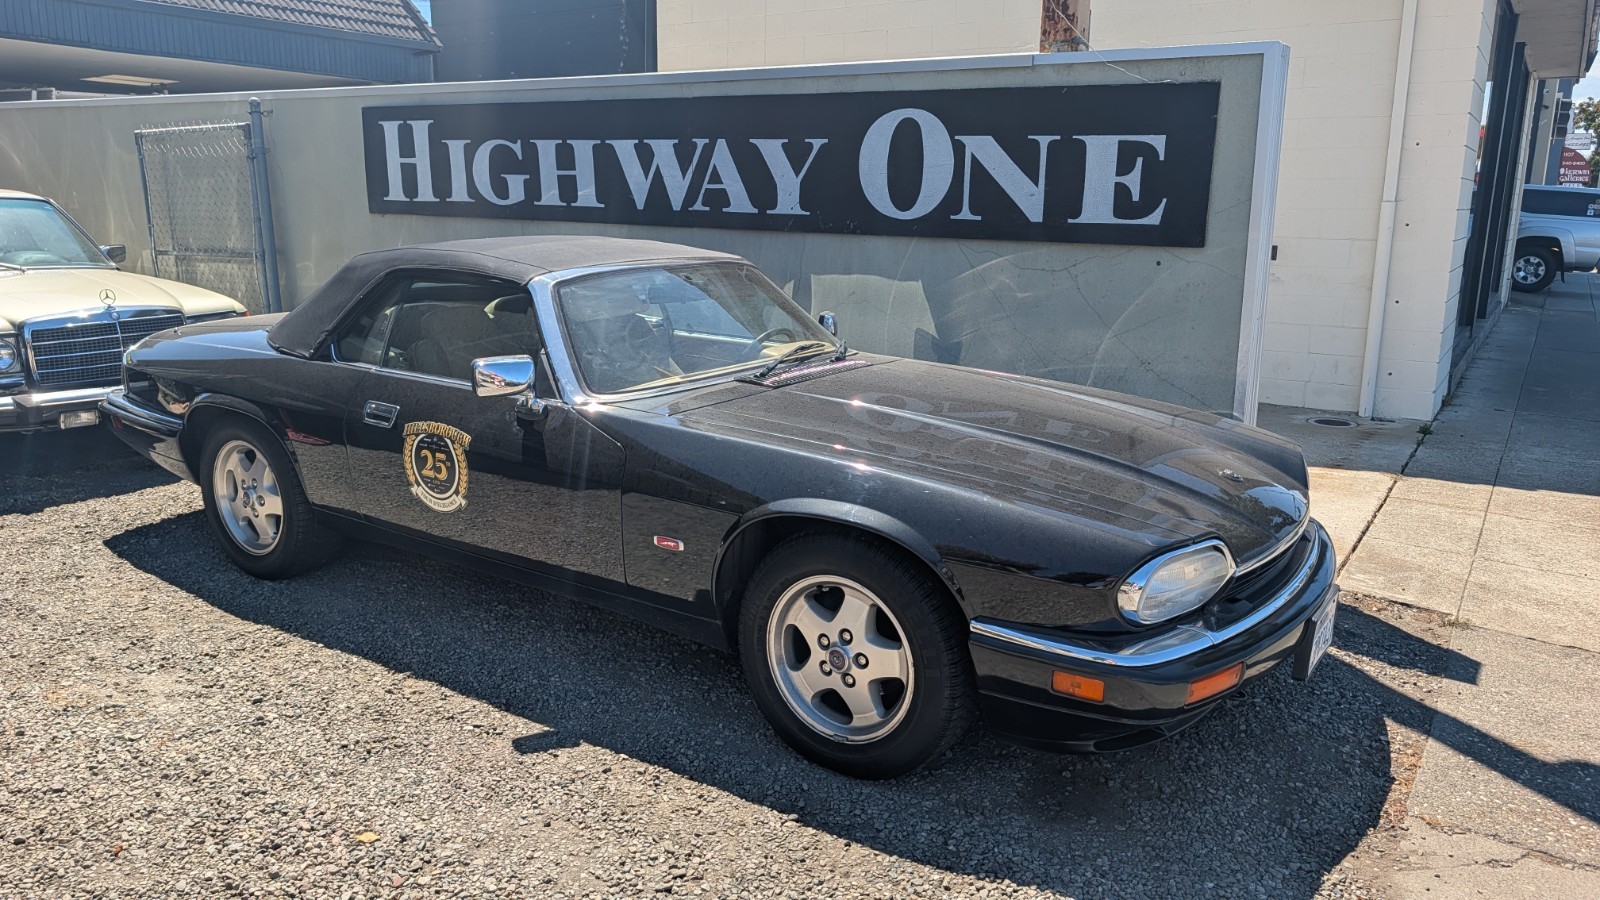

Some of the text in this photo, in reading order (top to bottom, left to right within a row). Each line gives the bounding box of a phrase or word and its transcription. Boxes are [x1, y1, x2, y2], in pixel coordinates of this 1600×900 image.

[377, 107, 1168, 227] HIGHWAY ONE
[403, 421, 472, 450] HILLSBOROUGH
